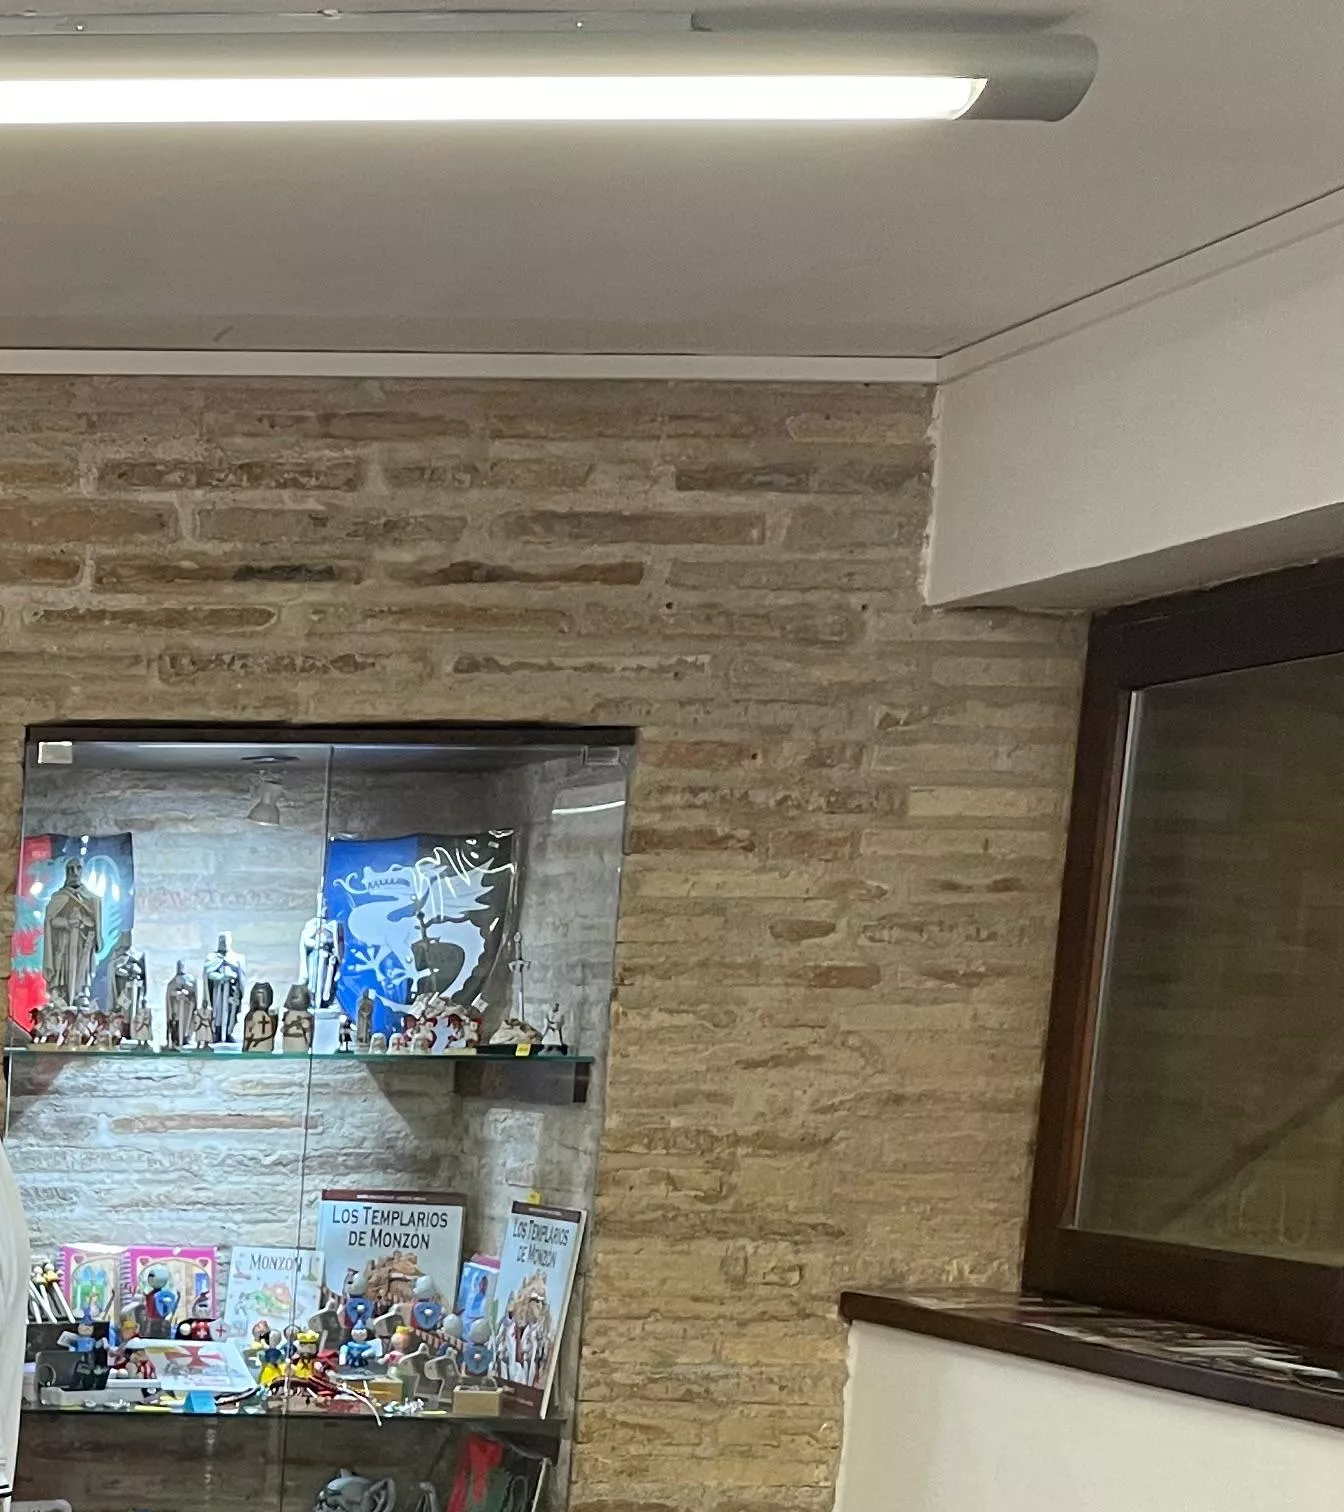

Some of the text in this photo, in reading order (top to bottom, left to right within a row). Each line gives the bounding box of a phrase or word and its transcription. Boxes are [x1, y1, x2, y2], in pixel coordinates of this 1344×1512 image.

[332, 1205, 449, 1229] LOS TEMPLARIOS
[348, 1230, 367, 1247] DE
[512, 1217, 570, 1247] LOS TEMPLARIOS
[516, 1244, 528, 1263] DE
